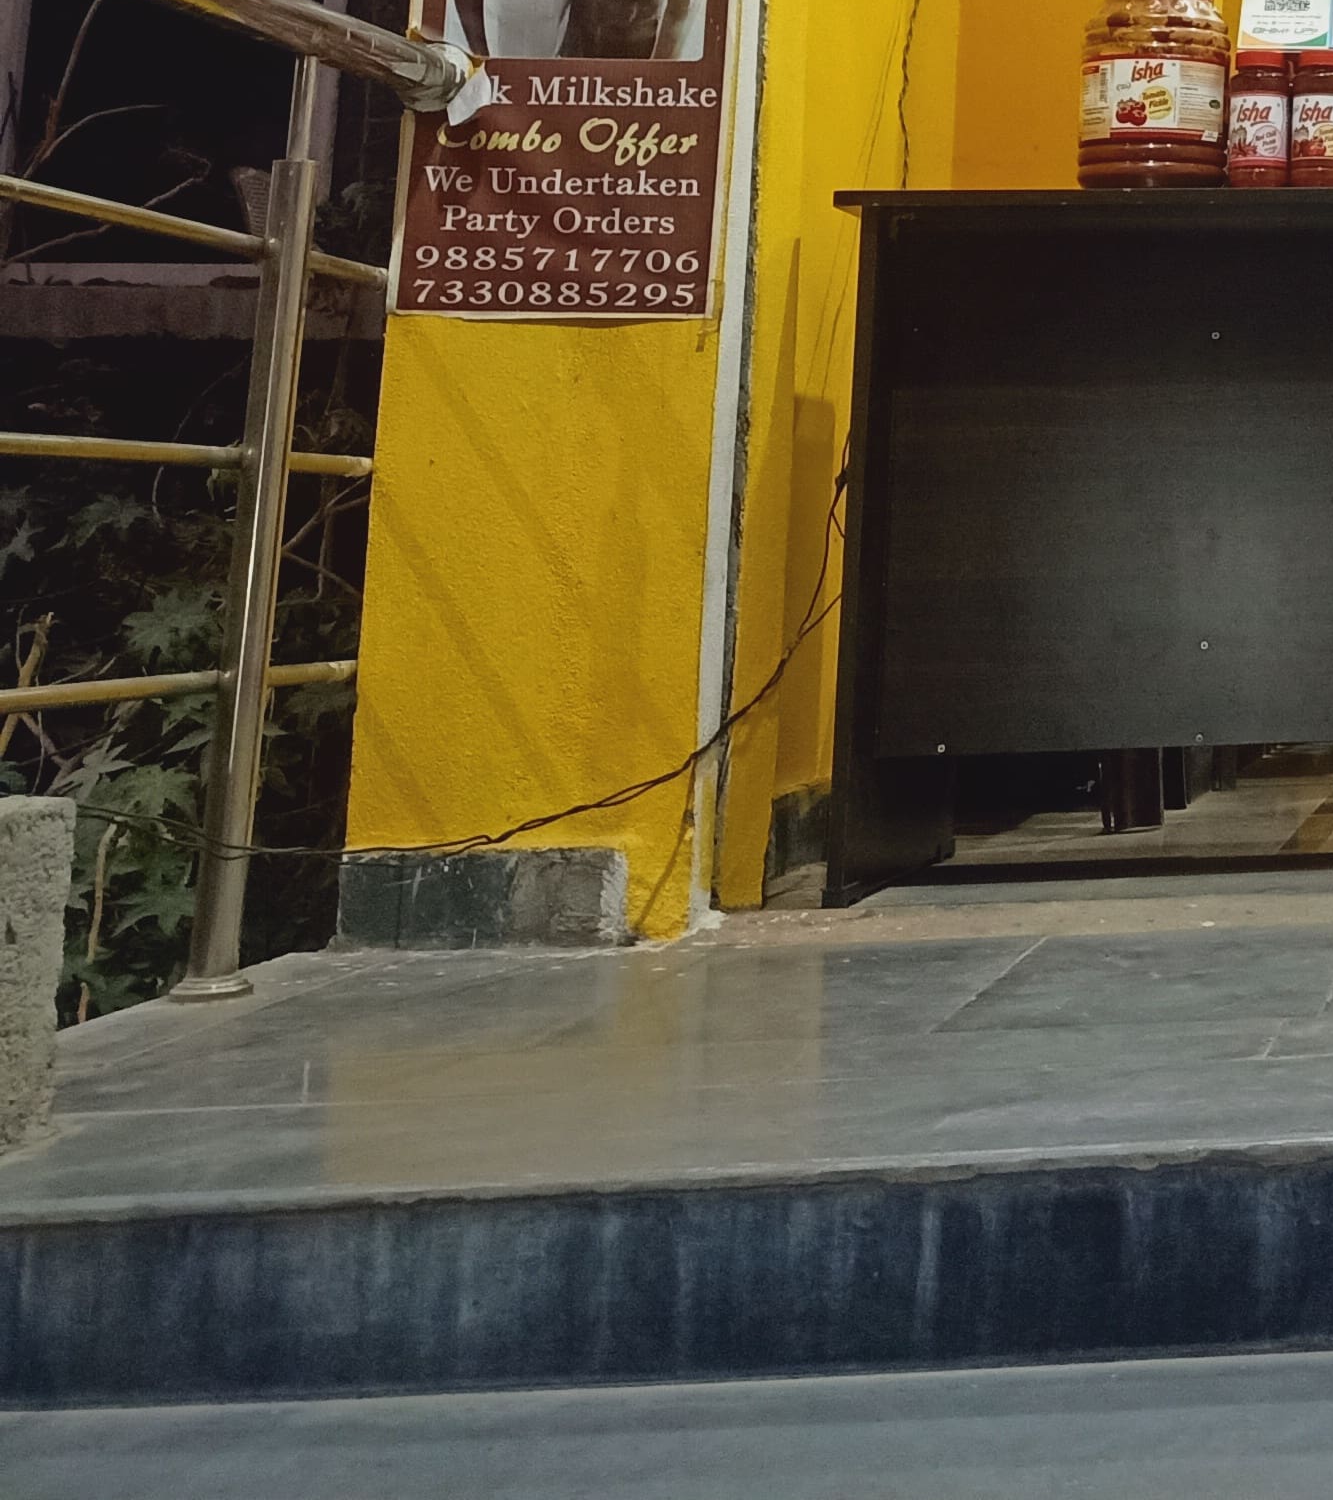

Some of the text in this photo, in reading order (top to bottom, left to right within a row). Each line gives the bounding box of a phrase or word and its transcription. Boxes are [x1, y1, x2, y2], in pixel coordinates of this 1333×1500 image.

[1131, 61, 1167, 83] isha
[528, 76, 718, 108] Milkshake
[1236, 99, 1273, 127] isha
[1299, 98, 1333, 127] isha
[578, 117, 698, 166] Offer
[423, 166, 700, 197] We Undertaken
[440, 205, 675, 239] Party Orders
[415, 245, 700, 274] 9885717706
[412, 279, 696, 308] 7330885295
